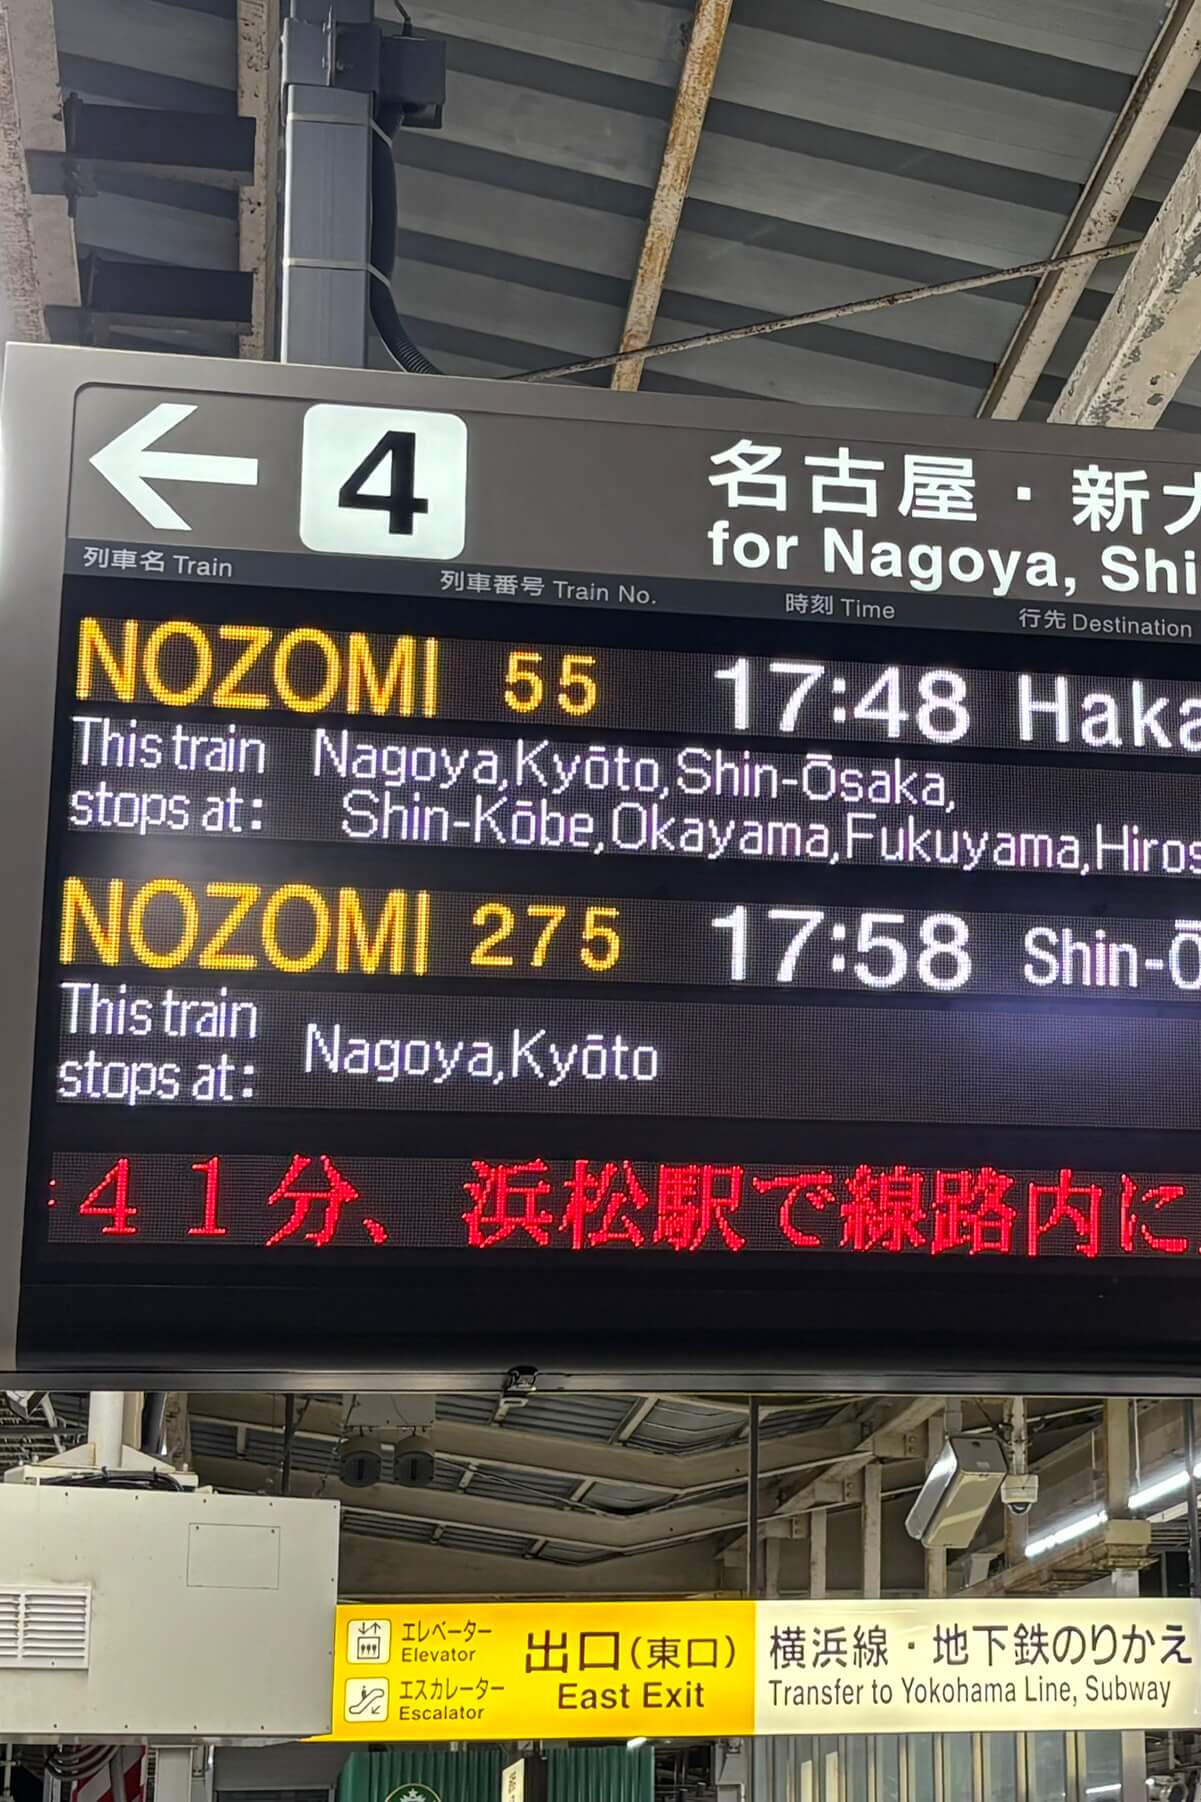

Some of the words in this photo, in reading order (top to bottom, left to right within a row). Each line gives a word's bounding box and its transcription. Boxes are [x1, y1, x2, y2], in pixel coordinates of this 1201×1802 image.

[339, 431, 427, 534] 4
[83, 547, 165, 573] 列車名
[173, 553, 233, 578] Train
[708, 525, 799, 570] for
[824, 529, 1077, 598] Nagoya,
[441, 571, 544, 595] 列車番号
[553, 581, 611, 603] Train
[617, 585, 657, 605] No.
[787, 594, 832, 614] 時刻
[841, 599, 894, 618] Time
[1020, 609, 1065, 628] 行先
[1074, 614, 1191, 637] Destination
[73, 617, 438, 717] NOZOMI
[505, 652, 596, 715] 55
[715, 659, 969, 743] 17:48
[60, 877, 430, 975] NOZOMI
[471, 903, 619, 971] 275
[712, 906, 971, 990] 17:58
[401, 1620, 492, 1642] エレベーター
[401, 1646, 476, 1663] Elevator
[399, 1678, 505, 1701] エスカレーター
[558, 1683, 630, 1709] East
[643, 1681, 704, 1707] Exit
[769, 1679, 864, 1706] Transfer
[871, 1679, 893, 1704] to
[901, 1676, 1016, 1704] Yokohama
[1024, 1675, 1077, 1707] Line,
[1085, 1675, 1171, 1707] Subway
[399, 1705, 485, 1721] Escalator
